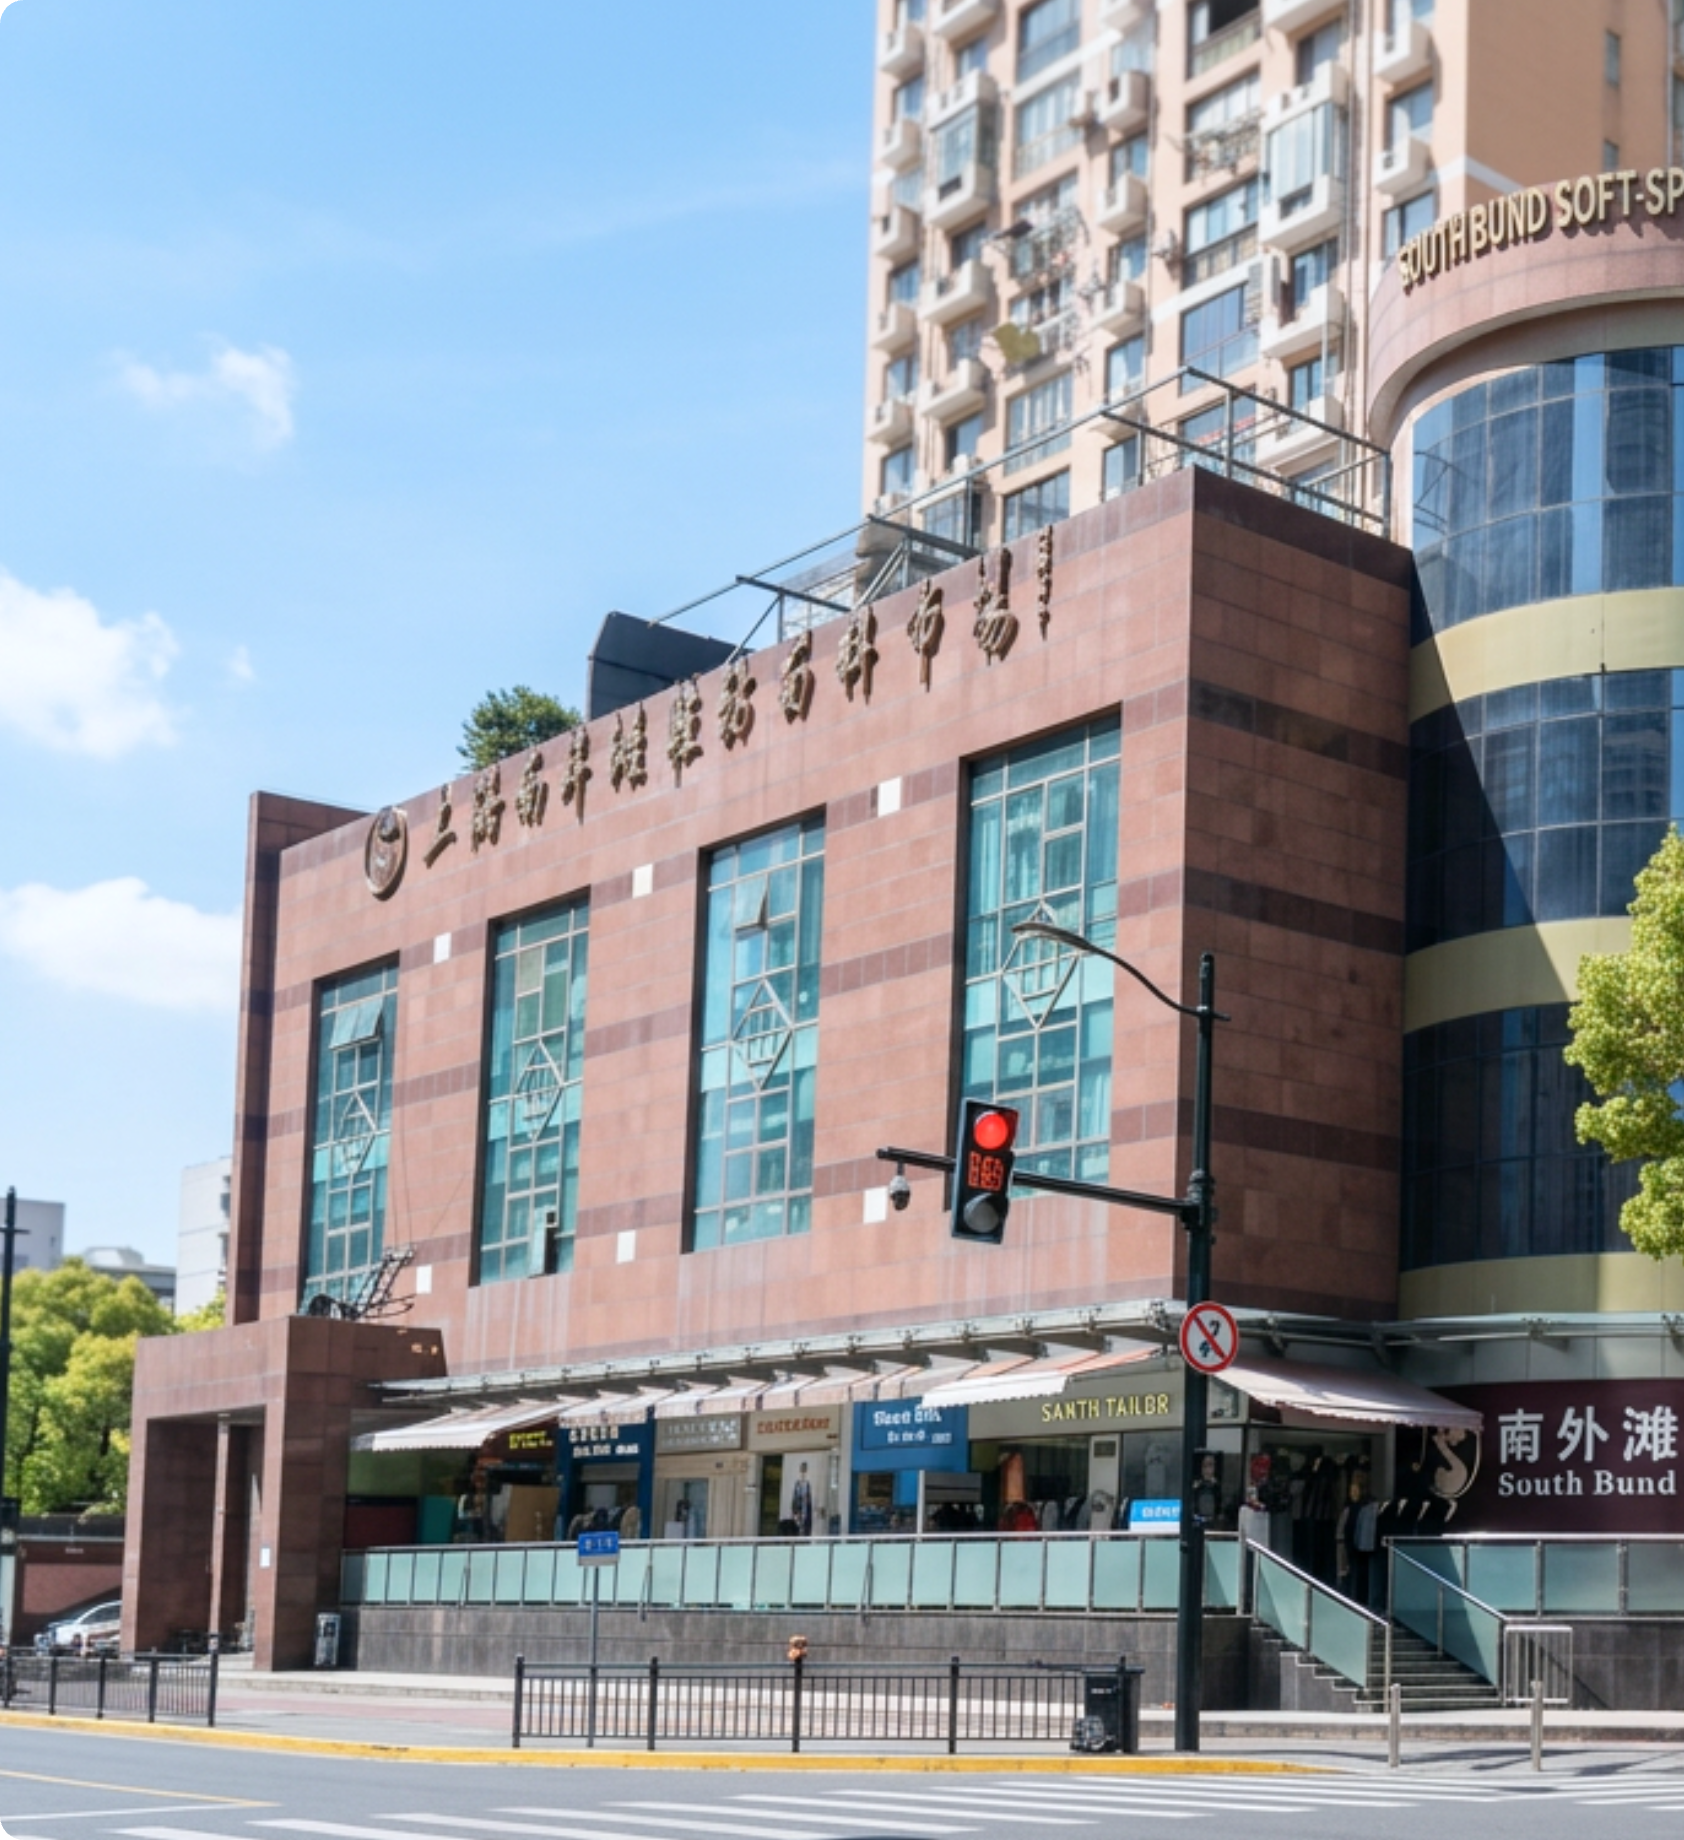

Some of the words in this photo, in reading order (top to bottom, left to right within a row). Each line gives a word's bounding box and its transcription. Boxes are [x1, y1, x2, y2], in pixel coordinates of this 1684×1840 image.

[1398, 210, 1469, 286] SOUTH
[1469, 187, 1547, 251] BUND
[1498, 1468, 1584, 1496] South
[1593, 1469, 1677, 1496] Bund
